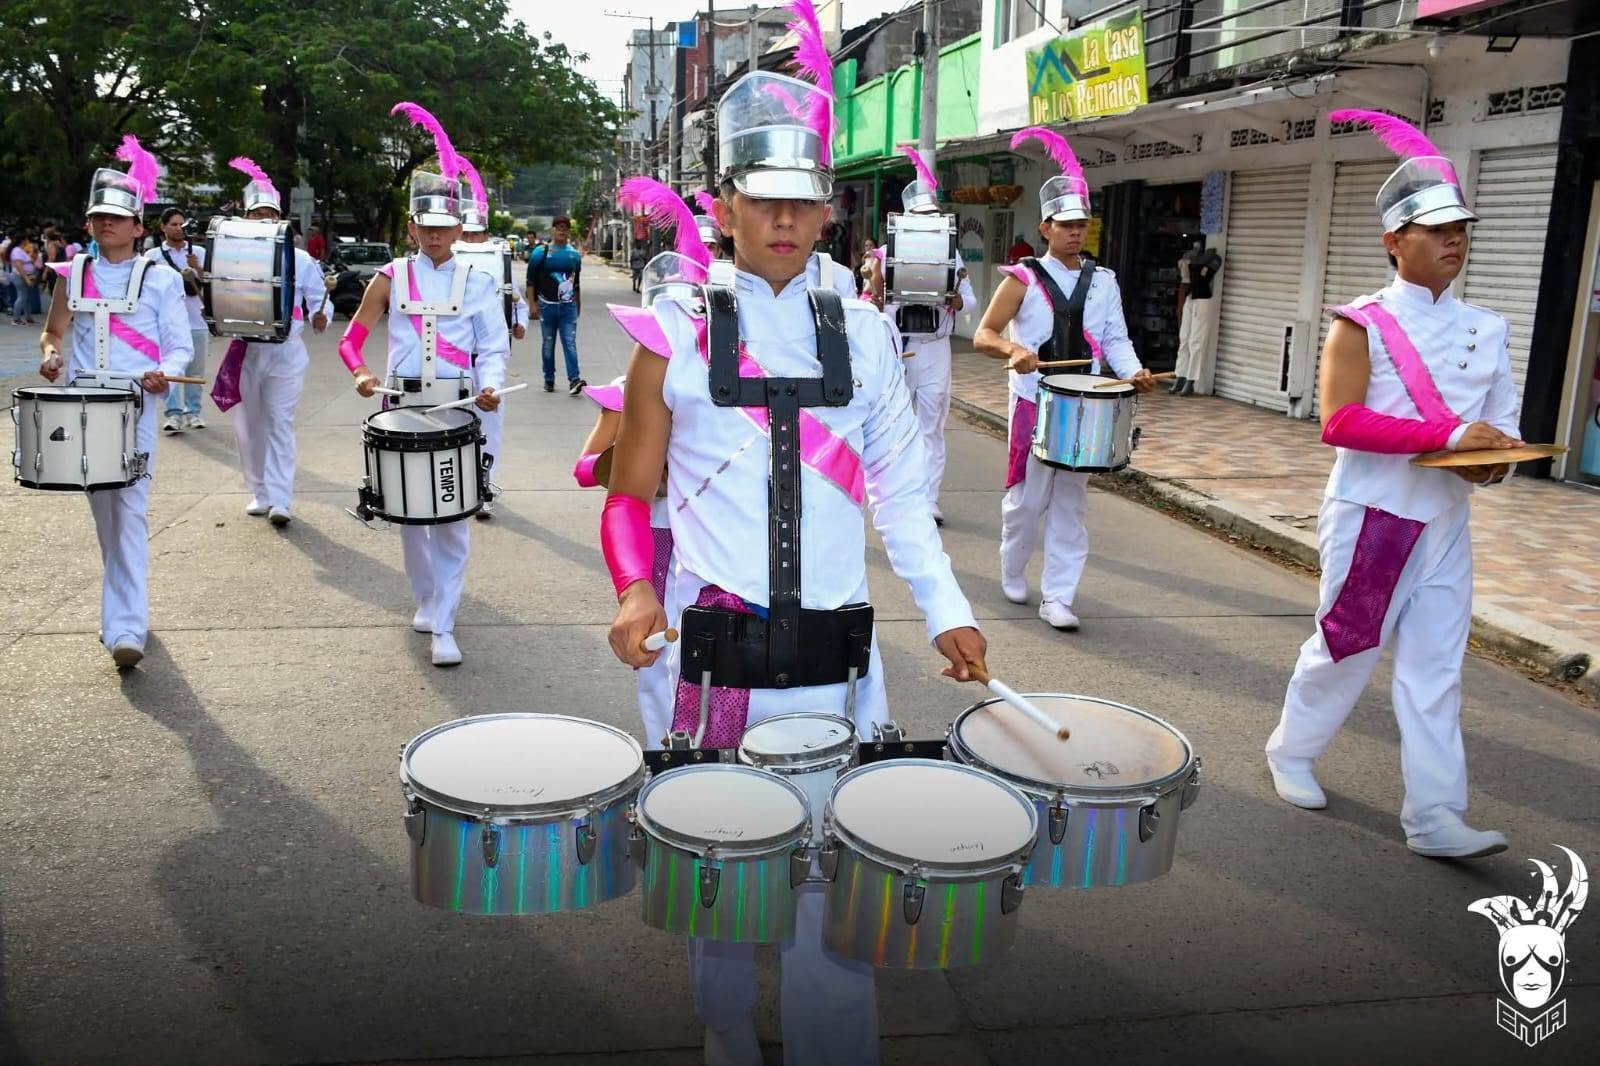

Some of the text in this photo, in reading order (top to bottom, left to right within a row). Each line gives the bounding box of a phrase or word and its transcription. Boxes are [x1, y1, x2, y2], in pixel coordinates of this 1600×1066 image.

[1083, 26, 1140, 70] La Casa
[1032, 74, 1141, 125] De Los Remates
[440, 457, 455, 503] TEMPO
